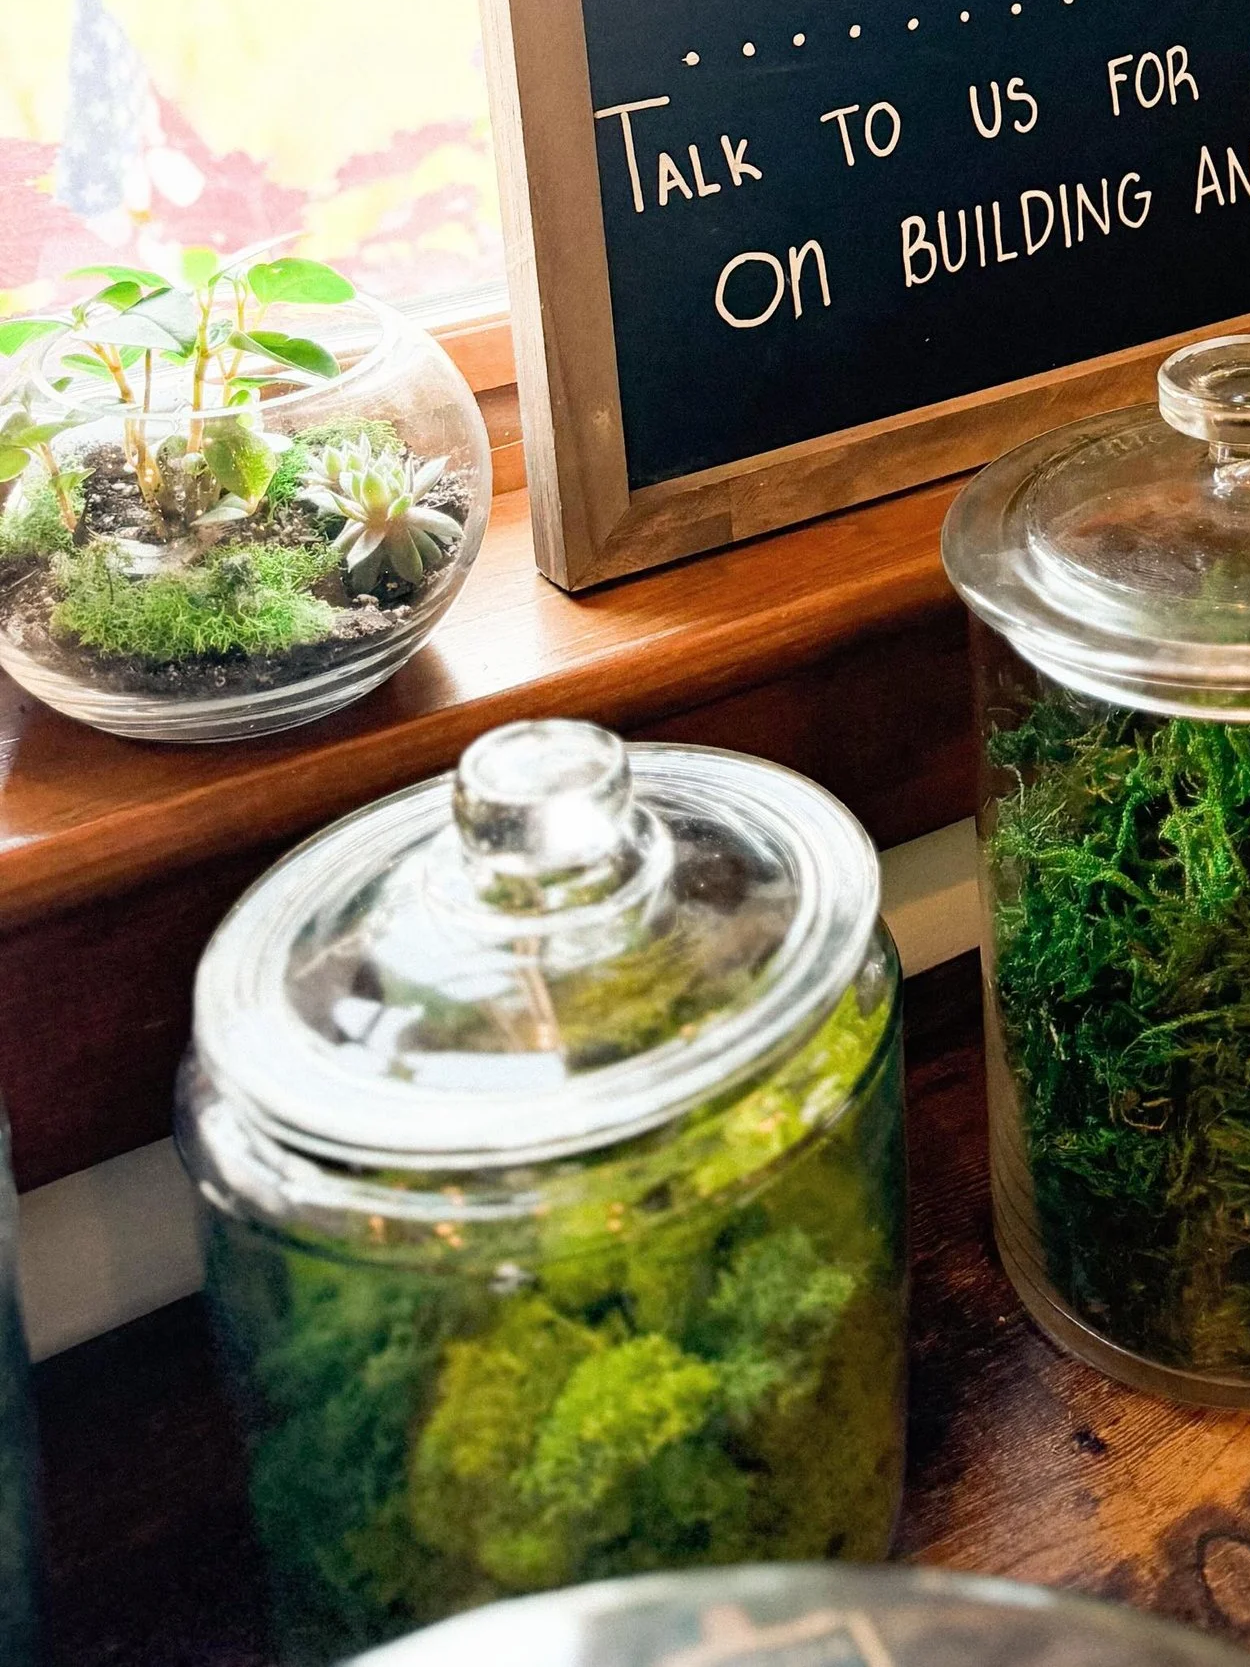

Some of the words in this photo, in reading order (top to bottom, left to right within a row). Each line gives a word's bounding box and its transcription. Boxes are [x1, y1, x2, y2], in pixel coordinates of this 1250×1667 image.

[820, 101, 901, 168] TO
[970, 76, 1038, 139] US
[1109, 44, 1200, 117] FOR
[901, 170, 1152, 287] BUILDING
